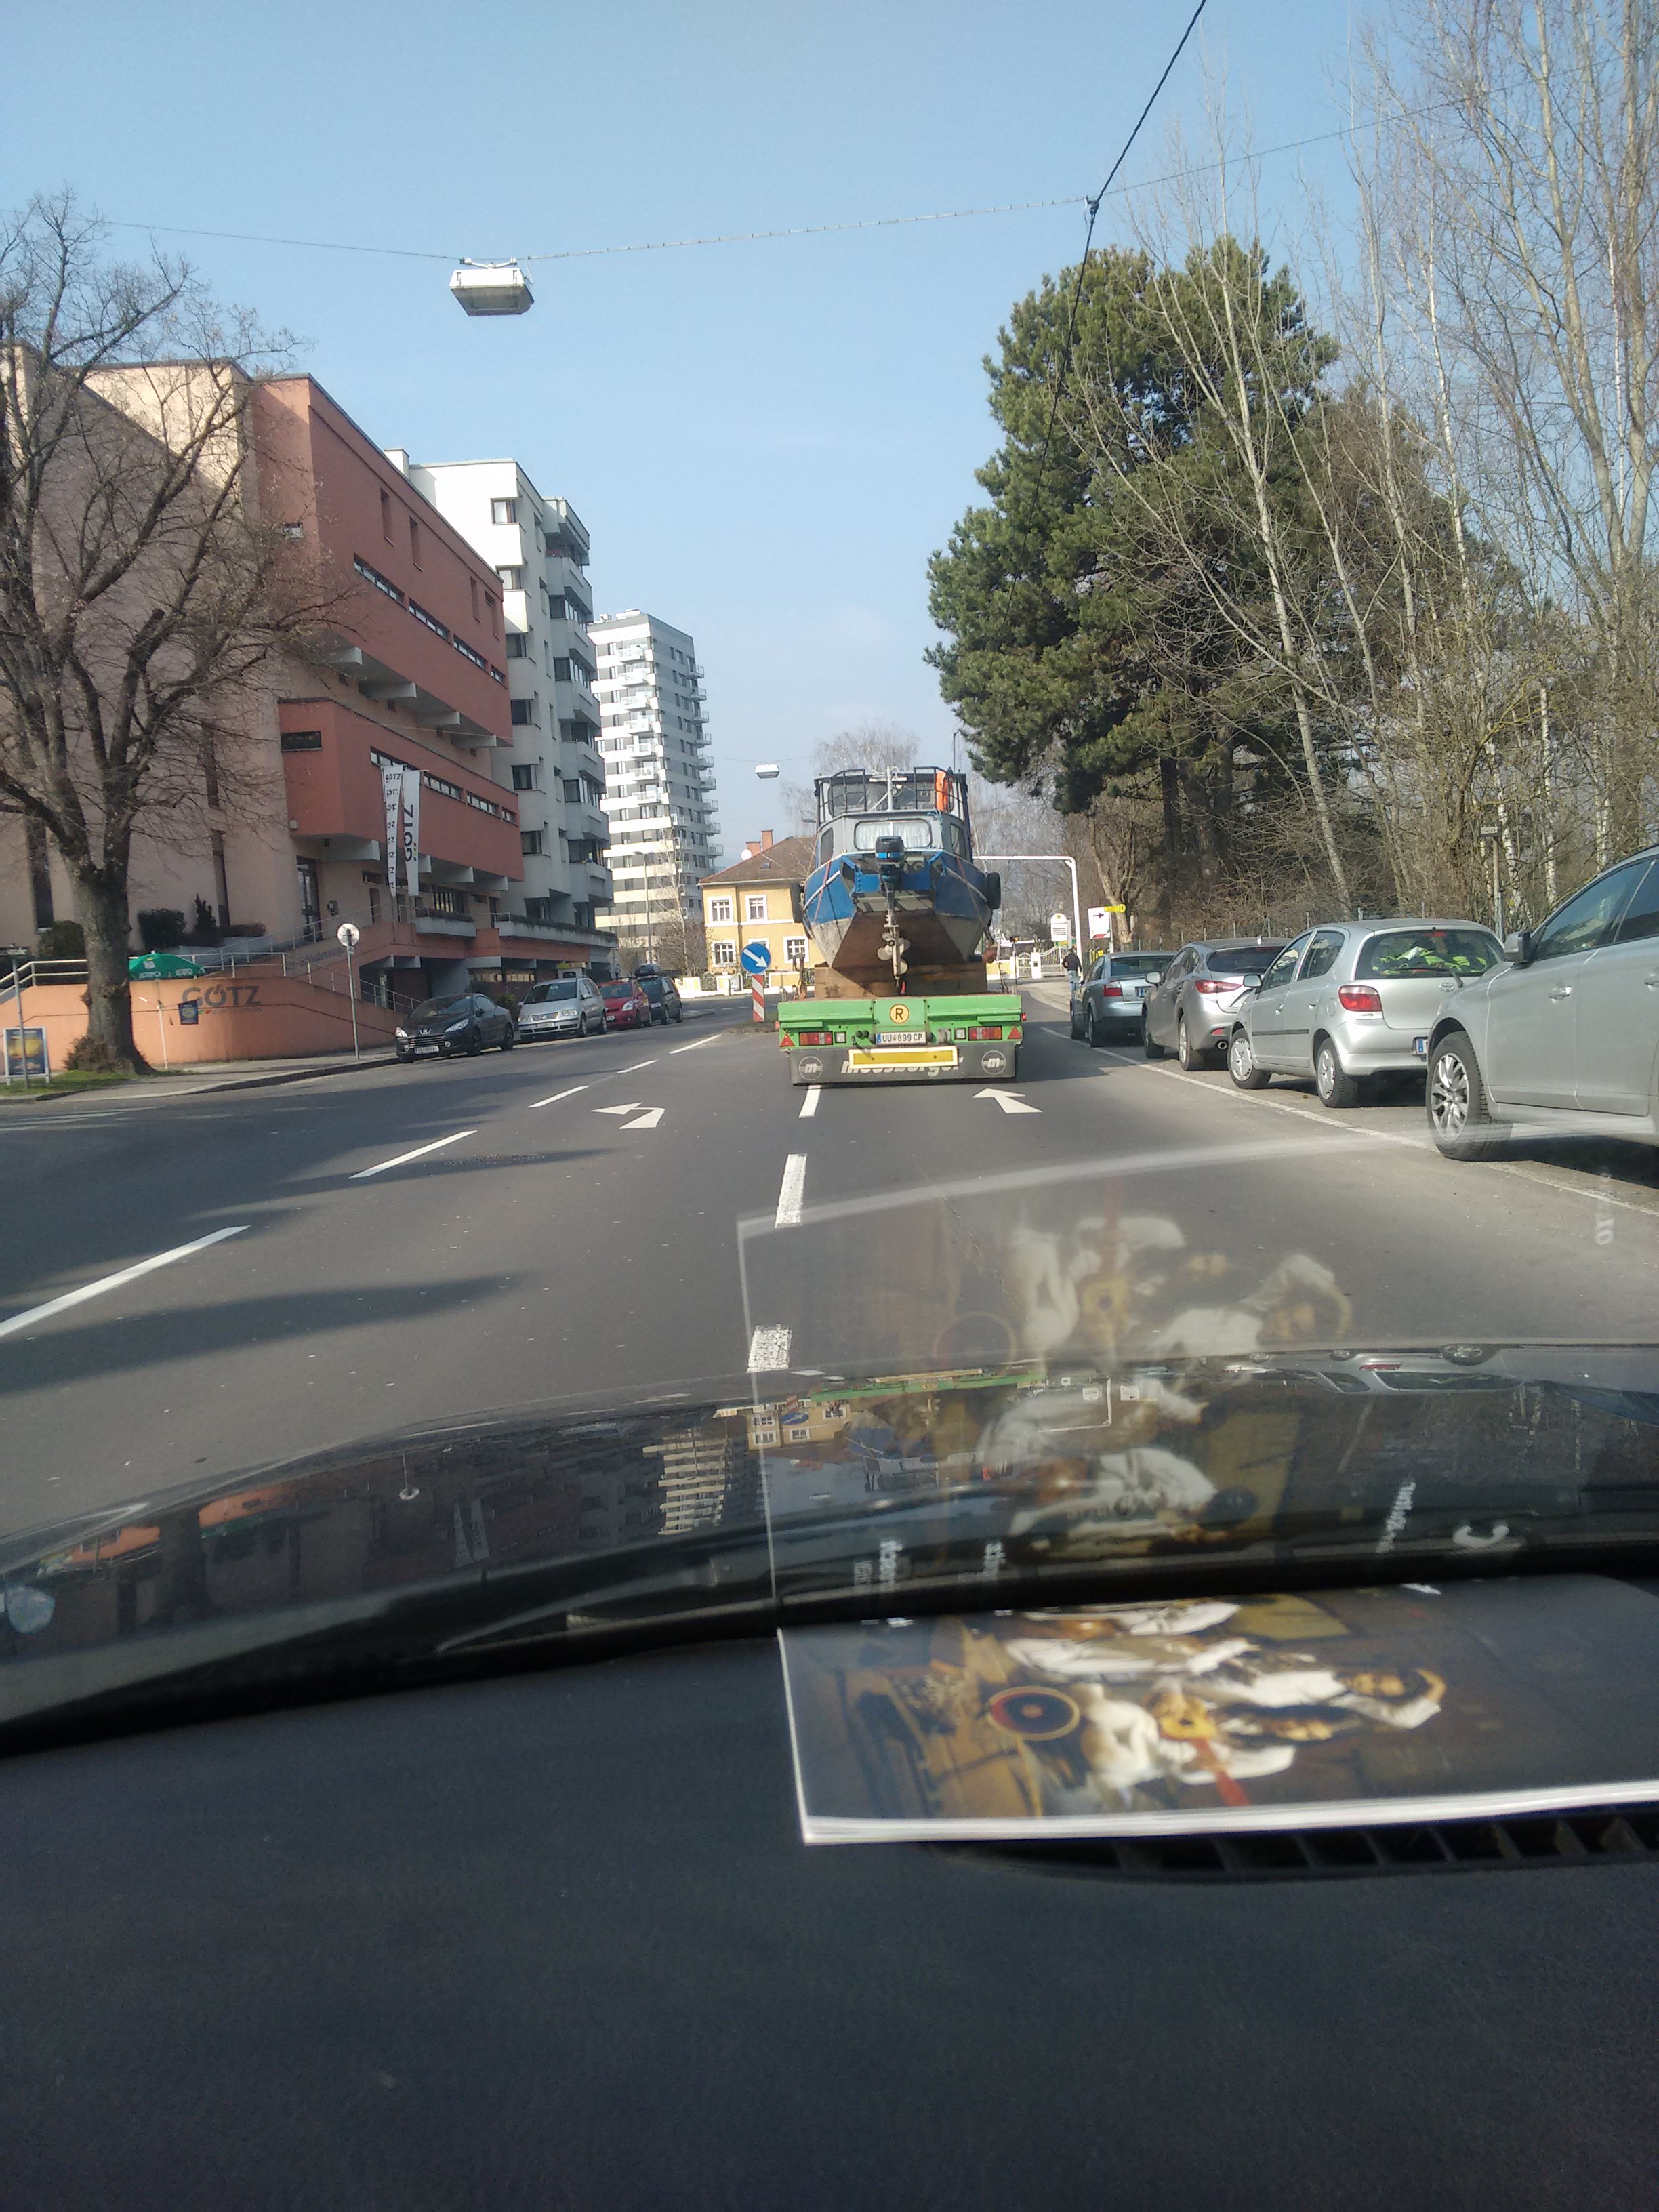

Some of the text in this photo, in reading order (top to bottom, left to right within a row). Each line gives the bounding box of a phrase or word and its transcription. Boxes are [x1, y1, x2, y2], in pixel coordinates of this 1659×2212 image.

[895, 1008, 904, 1020] R
[882, 1034, 892, 1042] UU
[897, 1033, 912, 1042] 899
